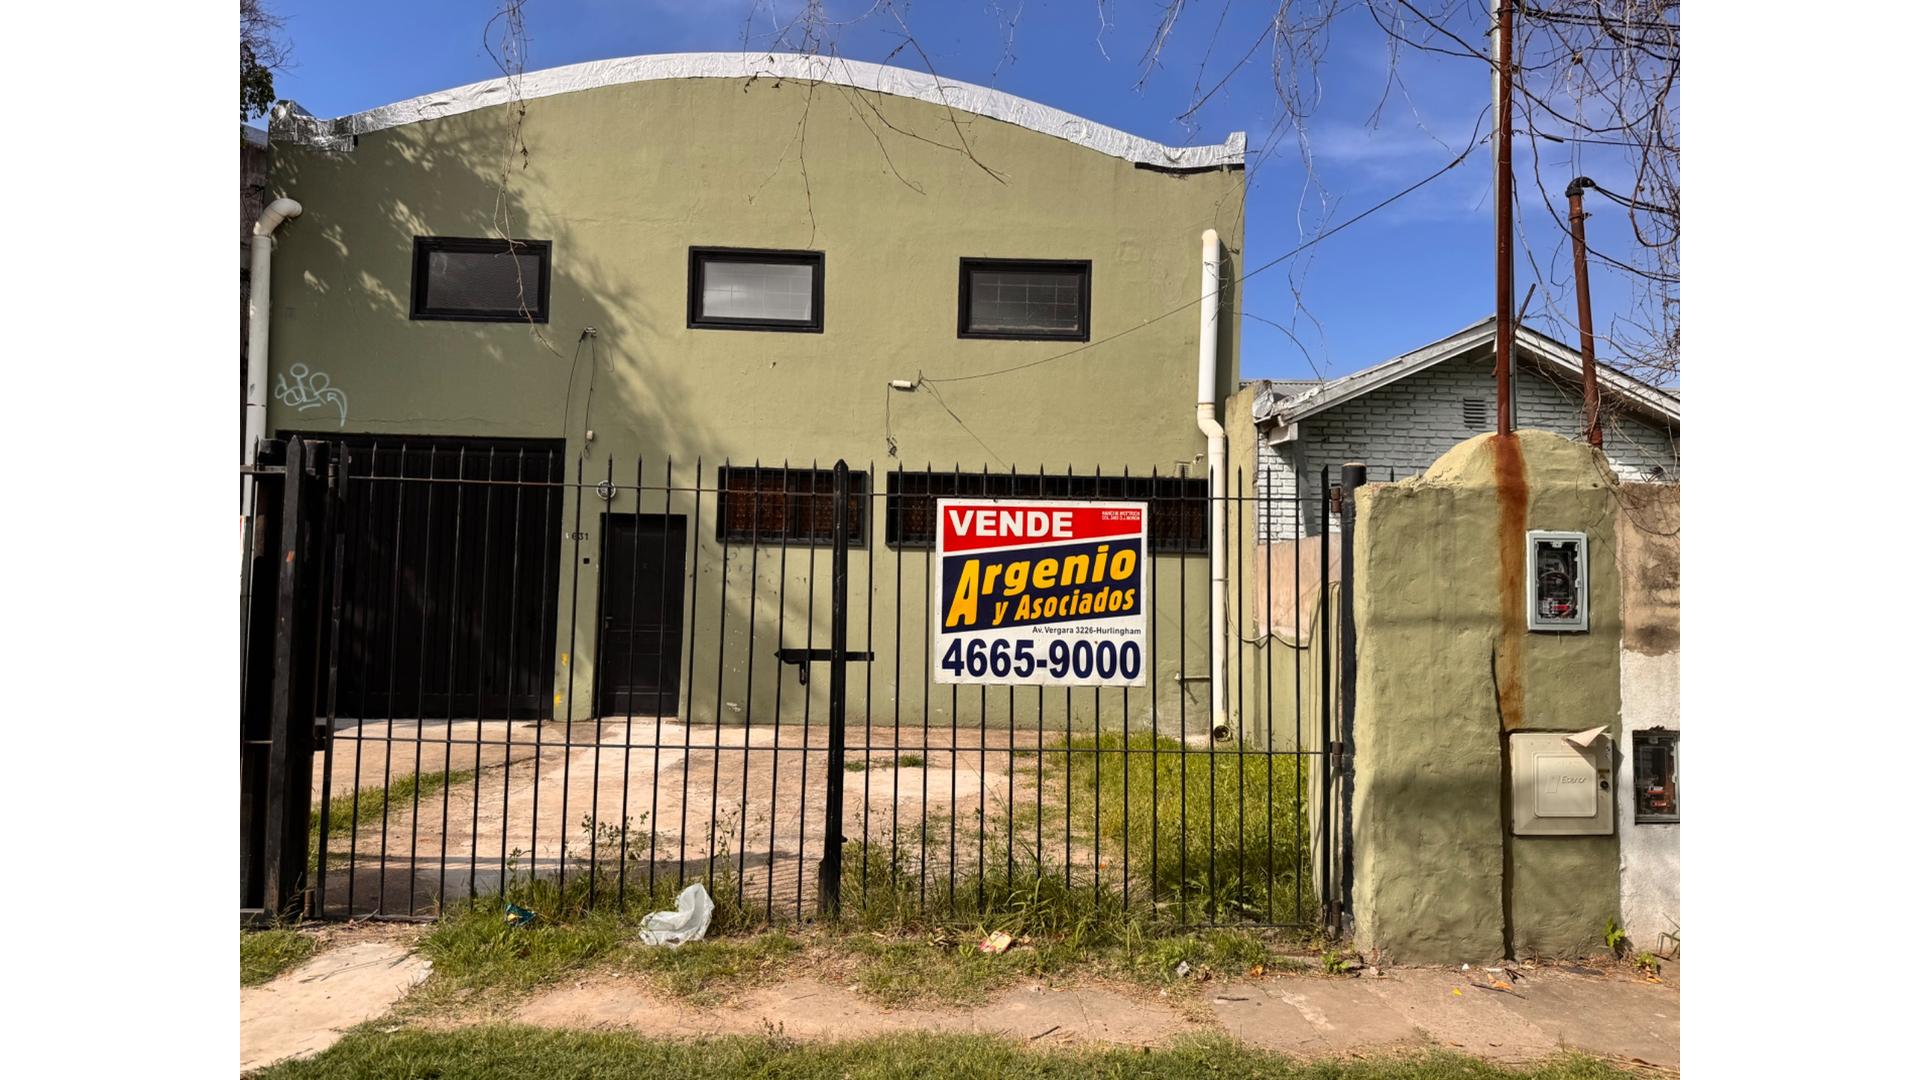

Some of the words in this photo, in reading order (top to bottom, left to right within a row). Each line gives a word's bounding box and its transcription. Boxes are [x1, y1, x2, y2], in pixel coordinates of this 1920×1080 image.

[949, 510, 1073, 538] VENDE
[945, 544, 1137, 628] Argenio
[992, 600, 1009, 626] y
[1014, 586, 1136, 621] Asociados
[1032, 626, 1043, 634] Av.
[1044, 626, 1074, 636] Vergara
[941, 638, 1141, 680] 4665-9000
